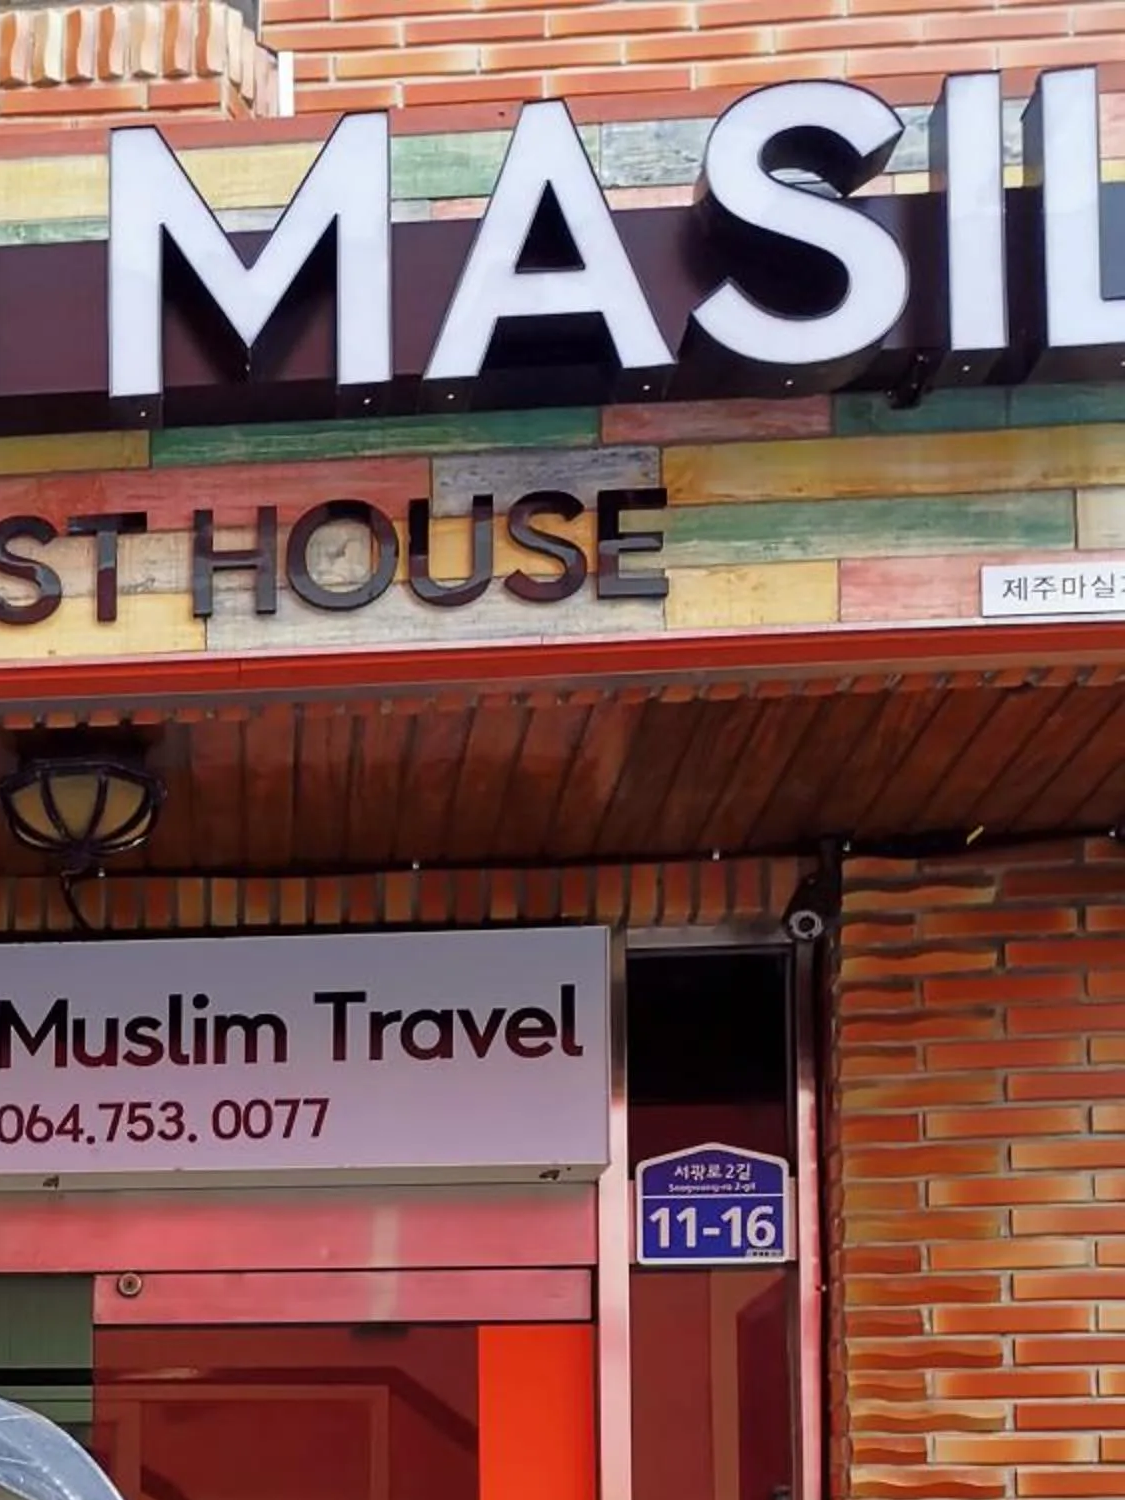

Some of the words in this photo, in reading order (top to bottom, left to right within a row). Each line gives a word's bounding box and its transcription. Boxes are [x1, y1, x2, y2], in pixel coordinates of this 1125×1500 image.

[108, 65, 1125, 396] MASIL
[191, 486, 669, 620] HOUSE
[1002, 572, 1125, 601] 제주마실
[313, 984, 583, 1062] Travel
[211, 1097, 331, 1141] 0077
[648, 1204, 776, 1249] 11-16
